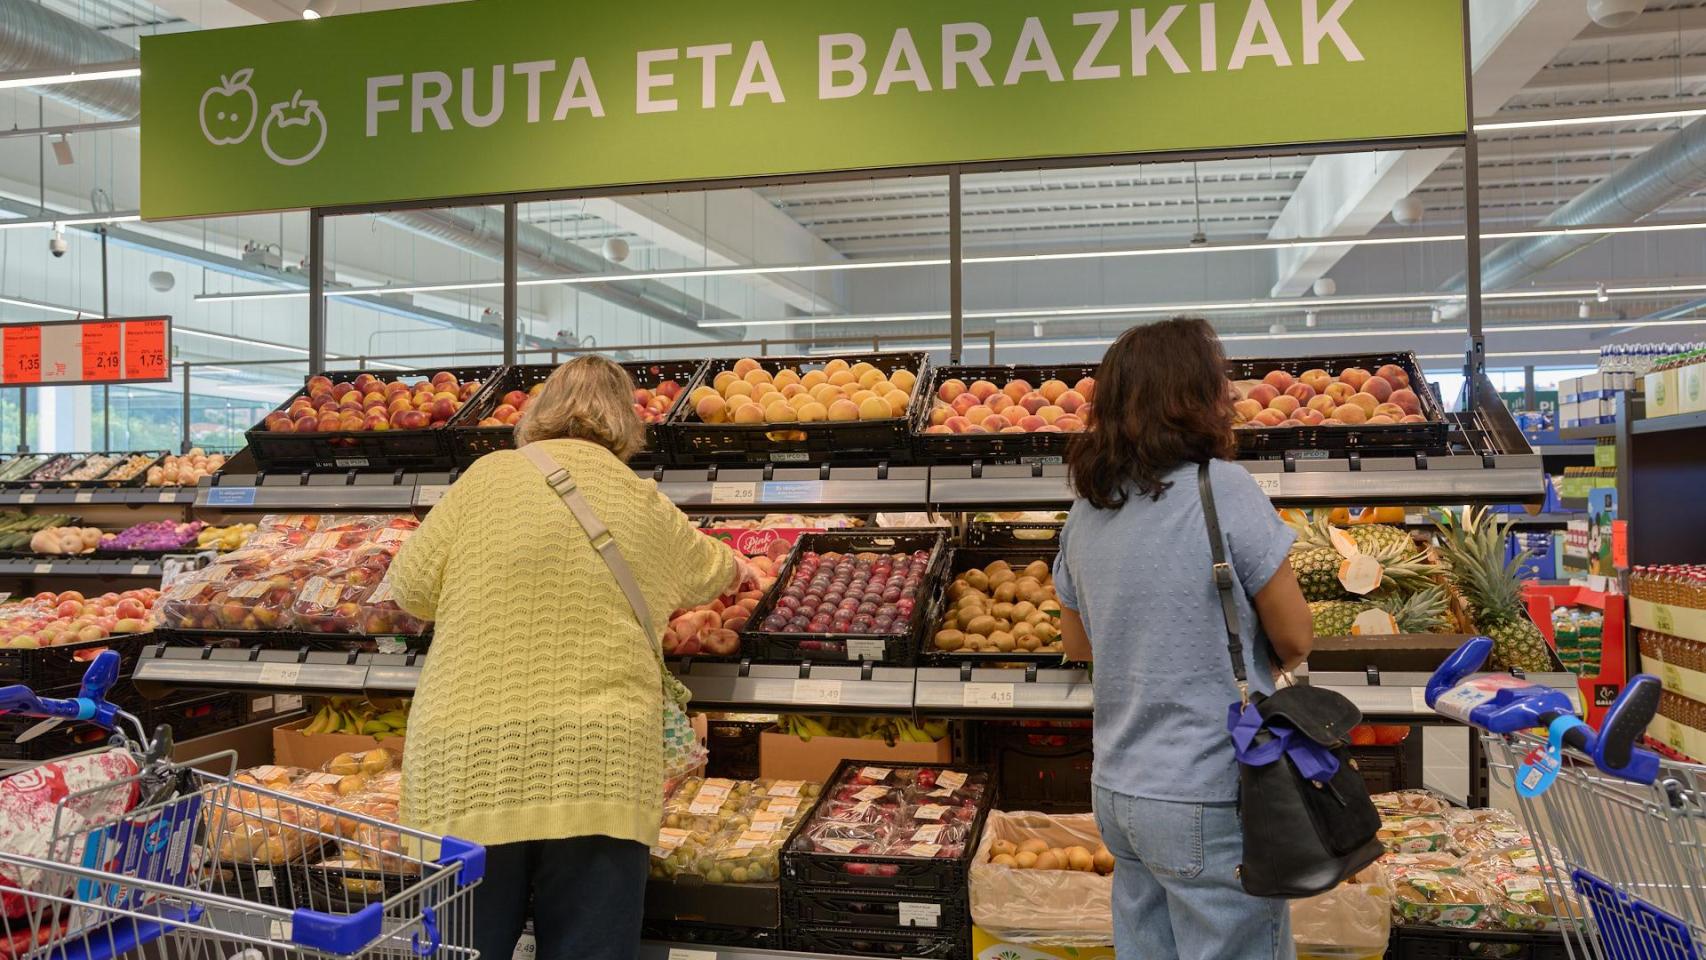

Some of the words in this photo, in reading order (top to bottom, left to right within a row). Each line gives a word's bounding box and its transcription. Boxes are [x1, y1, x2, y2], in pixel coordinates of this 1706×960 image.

[366, 57, 605, 137] FRUTA
[636, 41, 787, 114] ETA
[818, 0, 1365, 100] BARAZKIAK
[18, 359, 40, 372] 1,35
[97, 356, 119, 369] 2,19
[140, 354, 163, 368] 1,75
[1258, 480, 1279, 488] 2,75
[735, 490, 753, 498] 2,95
[744, 532, 771, 549] Pink
[991, 692, 1012, 702] 4,15
[516, 942, 535, 953] 2,49
